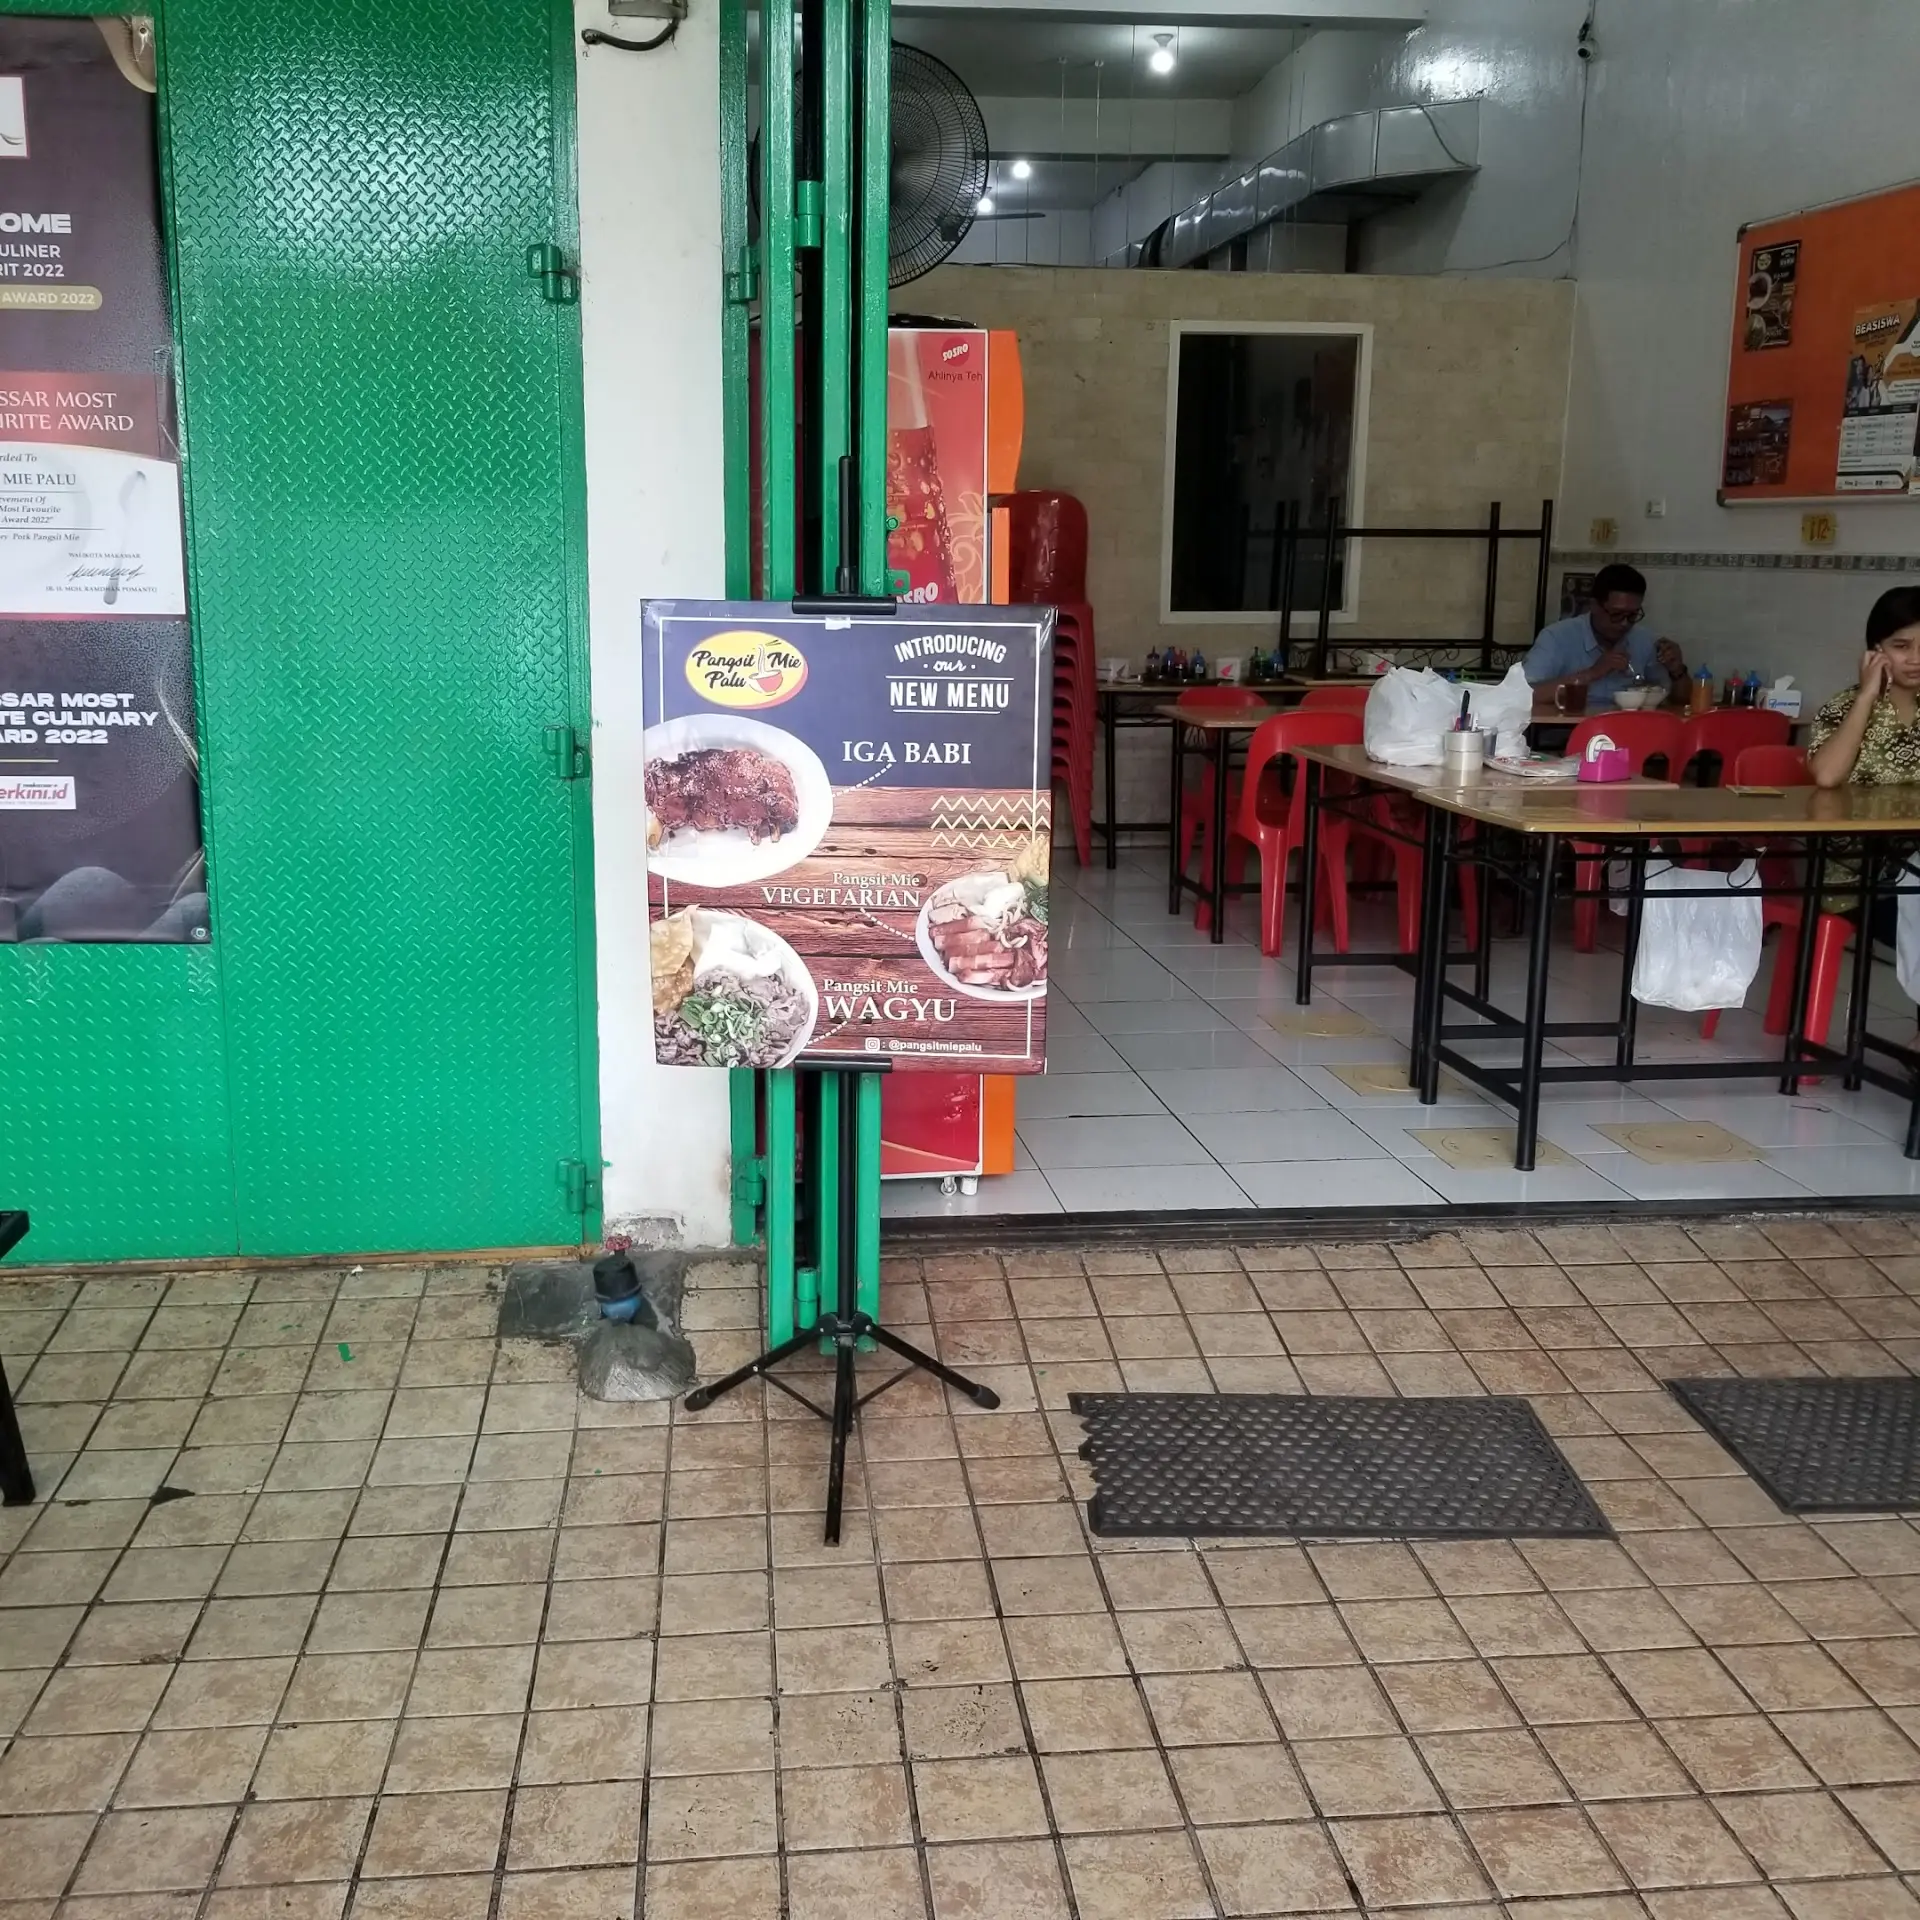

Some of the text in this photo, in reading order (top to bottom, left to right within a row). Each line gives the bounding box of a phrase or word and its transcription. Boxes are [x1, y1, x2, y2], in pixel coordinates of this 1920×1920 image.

[0, 212, 72, 234] OME
[23, 263, 65, 277] 2022
[2, 291, 96, 304] AWARD 2022
[1855, 315, 1900, 336] BEASISWA
[942, 343, 969, 362] SOSRO
[928, 370, 983, 383] Ahlinya Teh
[55, 391, 117, 408] MOST
[0, 413, 134, 431] RITE AWARD
[25, 453, 37, 462] To
[3, 473, 77, 486] MIE PALU
[35, 496, 47, 504] Of
[22, 505, 61, 513] Favourite
[12, 533, 31, 541] Pork
[33, 533, 62, 543] Pangsit
[894, 634, 1007, 664] INTRODUCING
[692, 650, 802, 670] Pangsit Mie
[932, 660, 967, 674] our
[704, 671, 747, 690] Palu
[0, 692, 134, 708] SAR MOST
[890, 681, 1010, 709] NEW MENU
[32, 710, 158, 726] CULINARY
[44, 728, 109, 744] 2022
[842, 740, 972, 765] IGA BABI
[832, 871, 920, 889] Pangsit Mie
[760, 886, 920, 907] VEGETARIAN
[823, 978, 919, 996] Pangsit Mie
[823, 995, 958, 1021] WAGYU
[888, 1039, 982, 1053] @pangsitmiepalu
